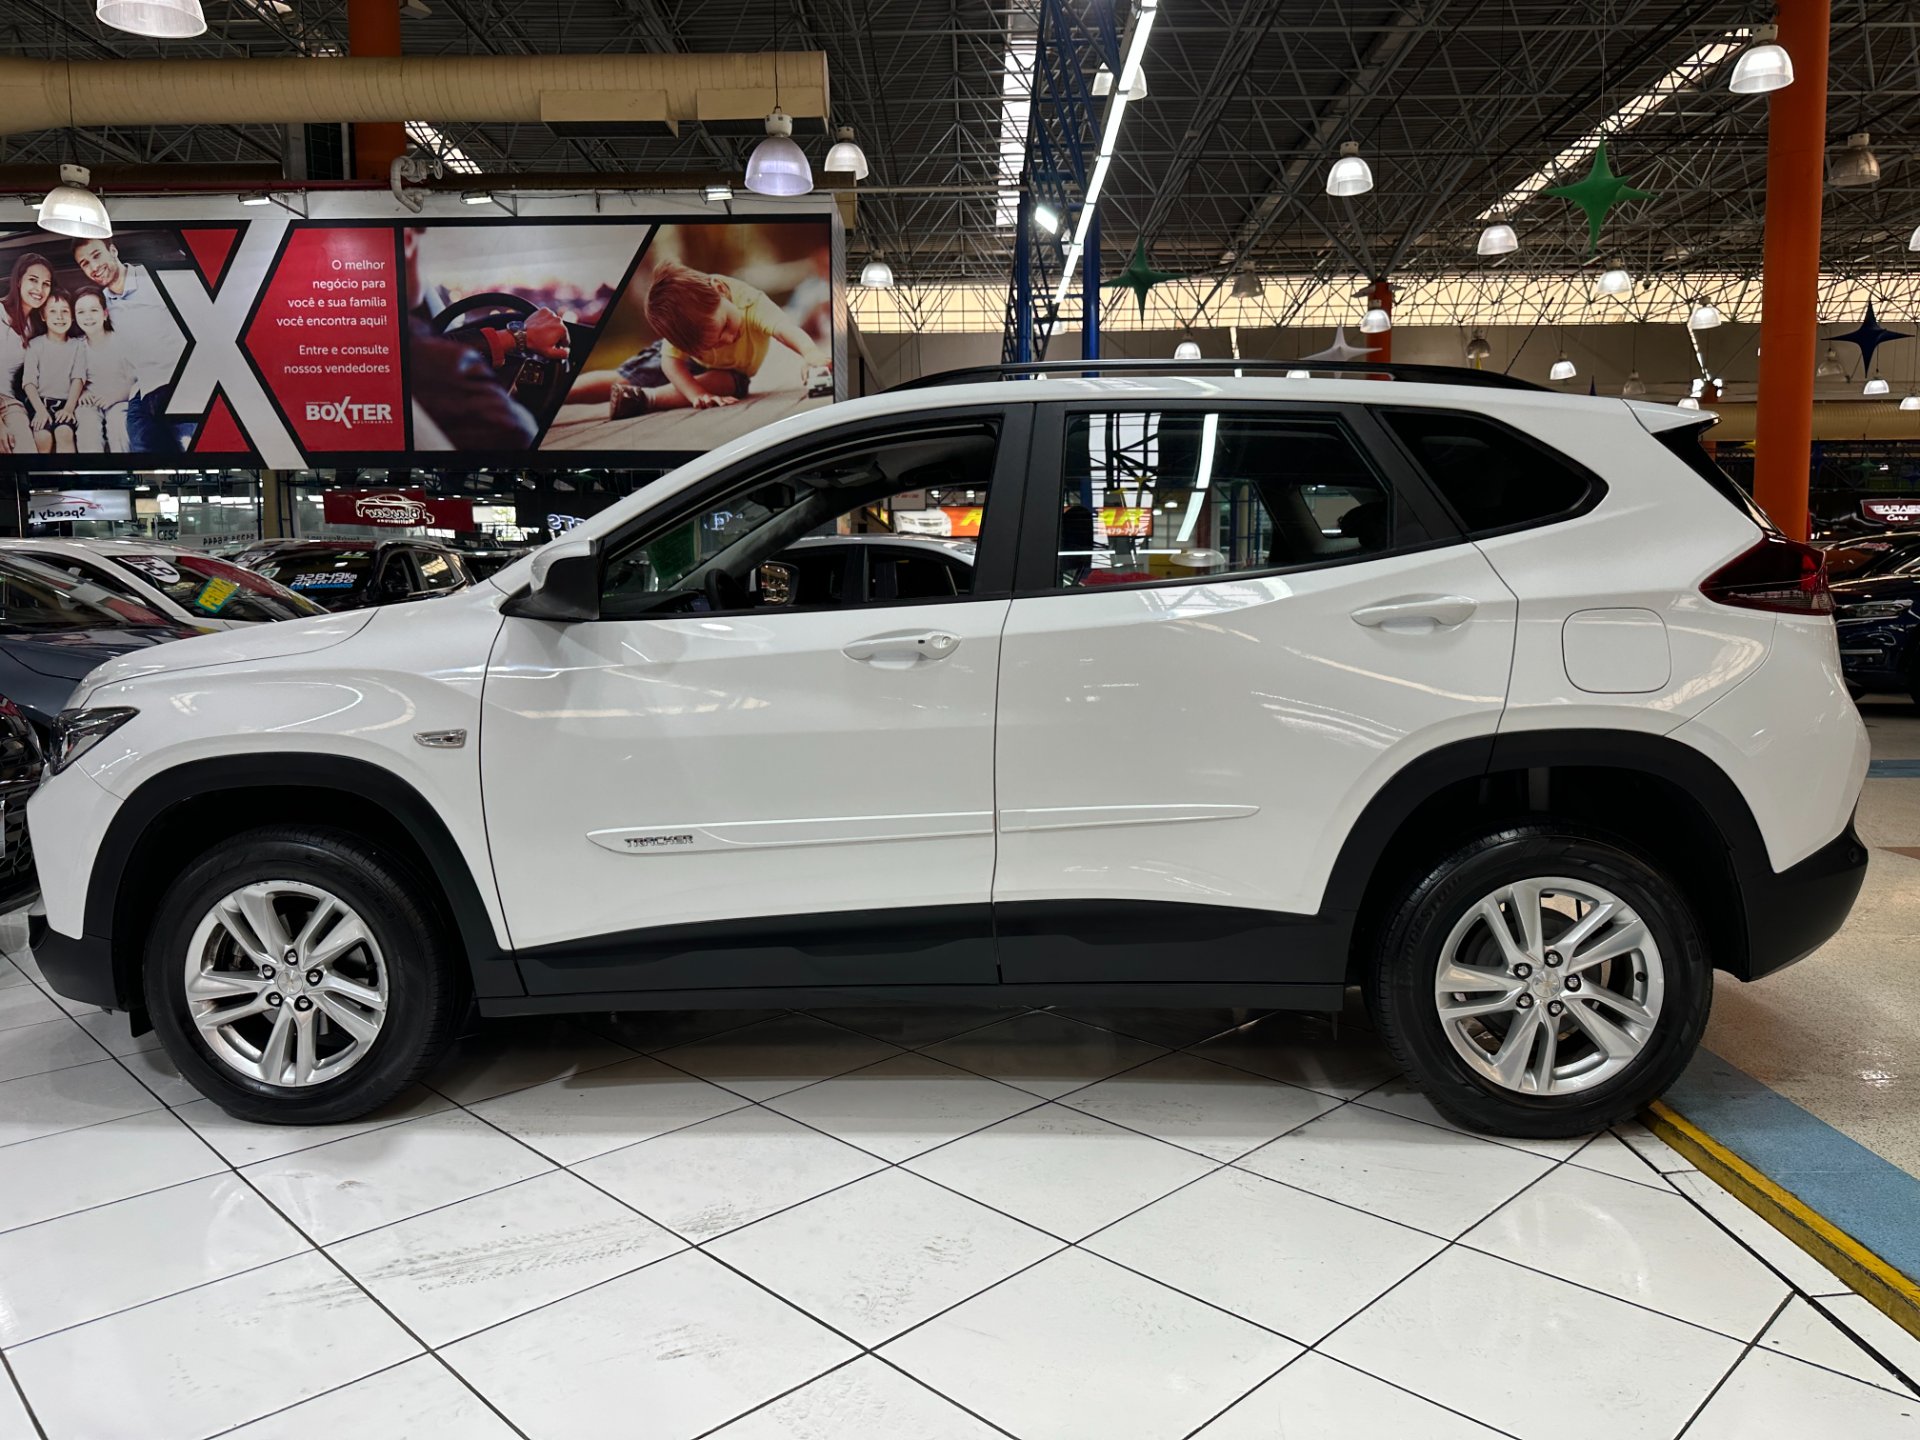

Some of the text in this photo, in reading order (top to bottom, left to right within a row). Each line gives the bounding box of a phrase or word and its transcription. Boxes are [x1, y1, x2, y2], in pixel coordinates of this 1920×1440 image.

[331, 259, 385, 270] O melhor
[312, 279, 386, 291] negócio para
[288, 296, 387, 308] você e sua família
[276, 315, 388, 328] você encontra aqui!
[299, 344, 389, 355] Entre e consulte
[284, 362, 391, 374] nossos vendedores
[305, 396, 392, 429] BOXTER
[624, 834, 694, 848] TRACKER
